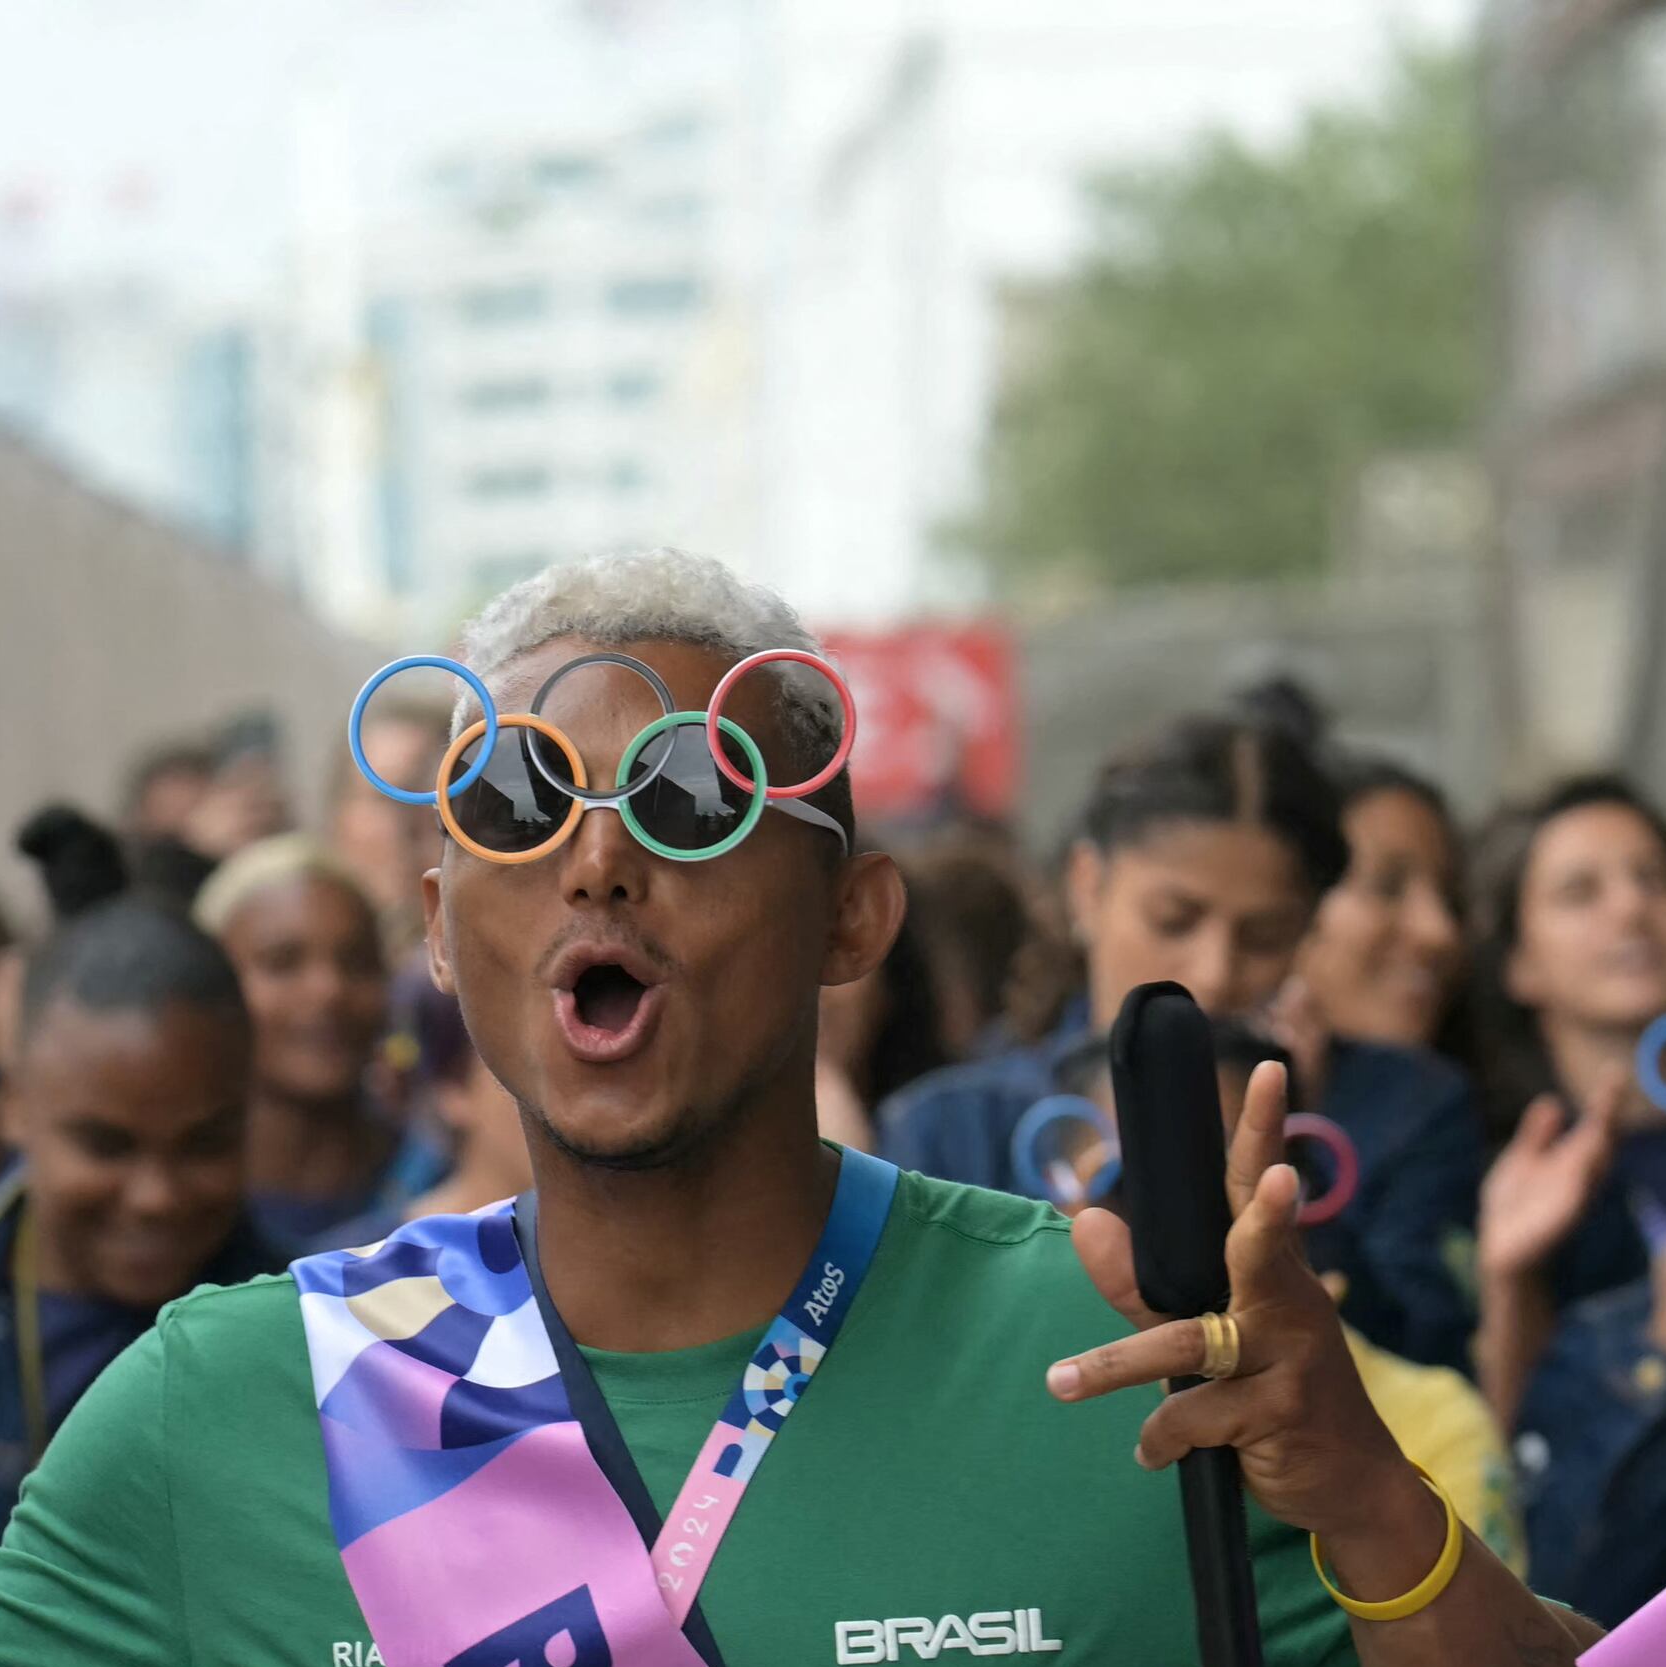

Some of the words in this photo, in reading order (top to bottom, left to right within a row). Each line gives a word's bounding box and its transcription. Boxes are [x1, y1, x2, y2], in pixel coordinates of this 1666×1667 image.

[803, 1262, 845, 1326] Atos
[658, 1495, 719, 1591] 2024
[834, 1607, 1063, 1665] BRASIL
